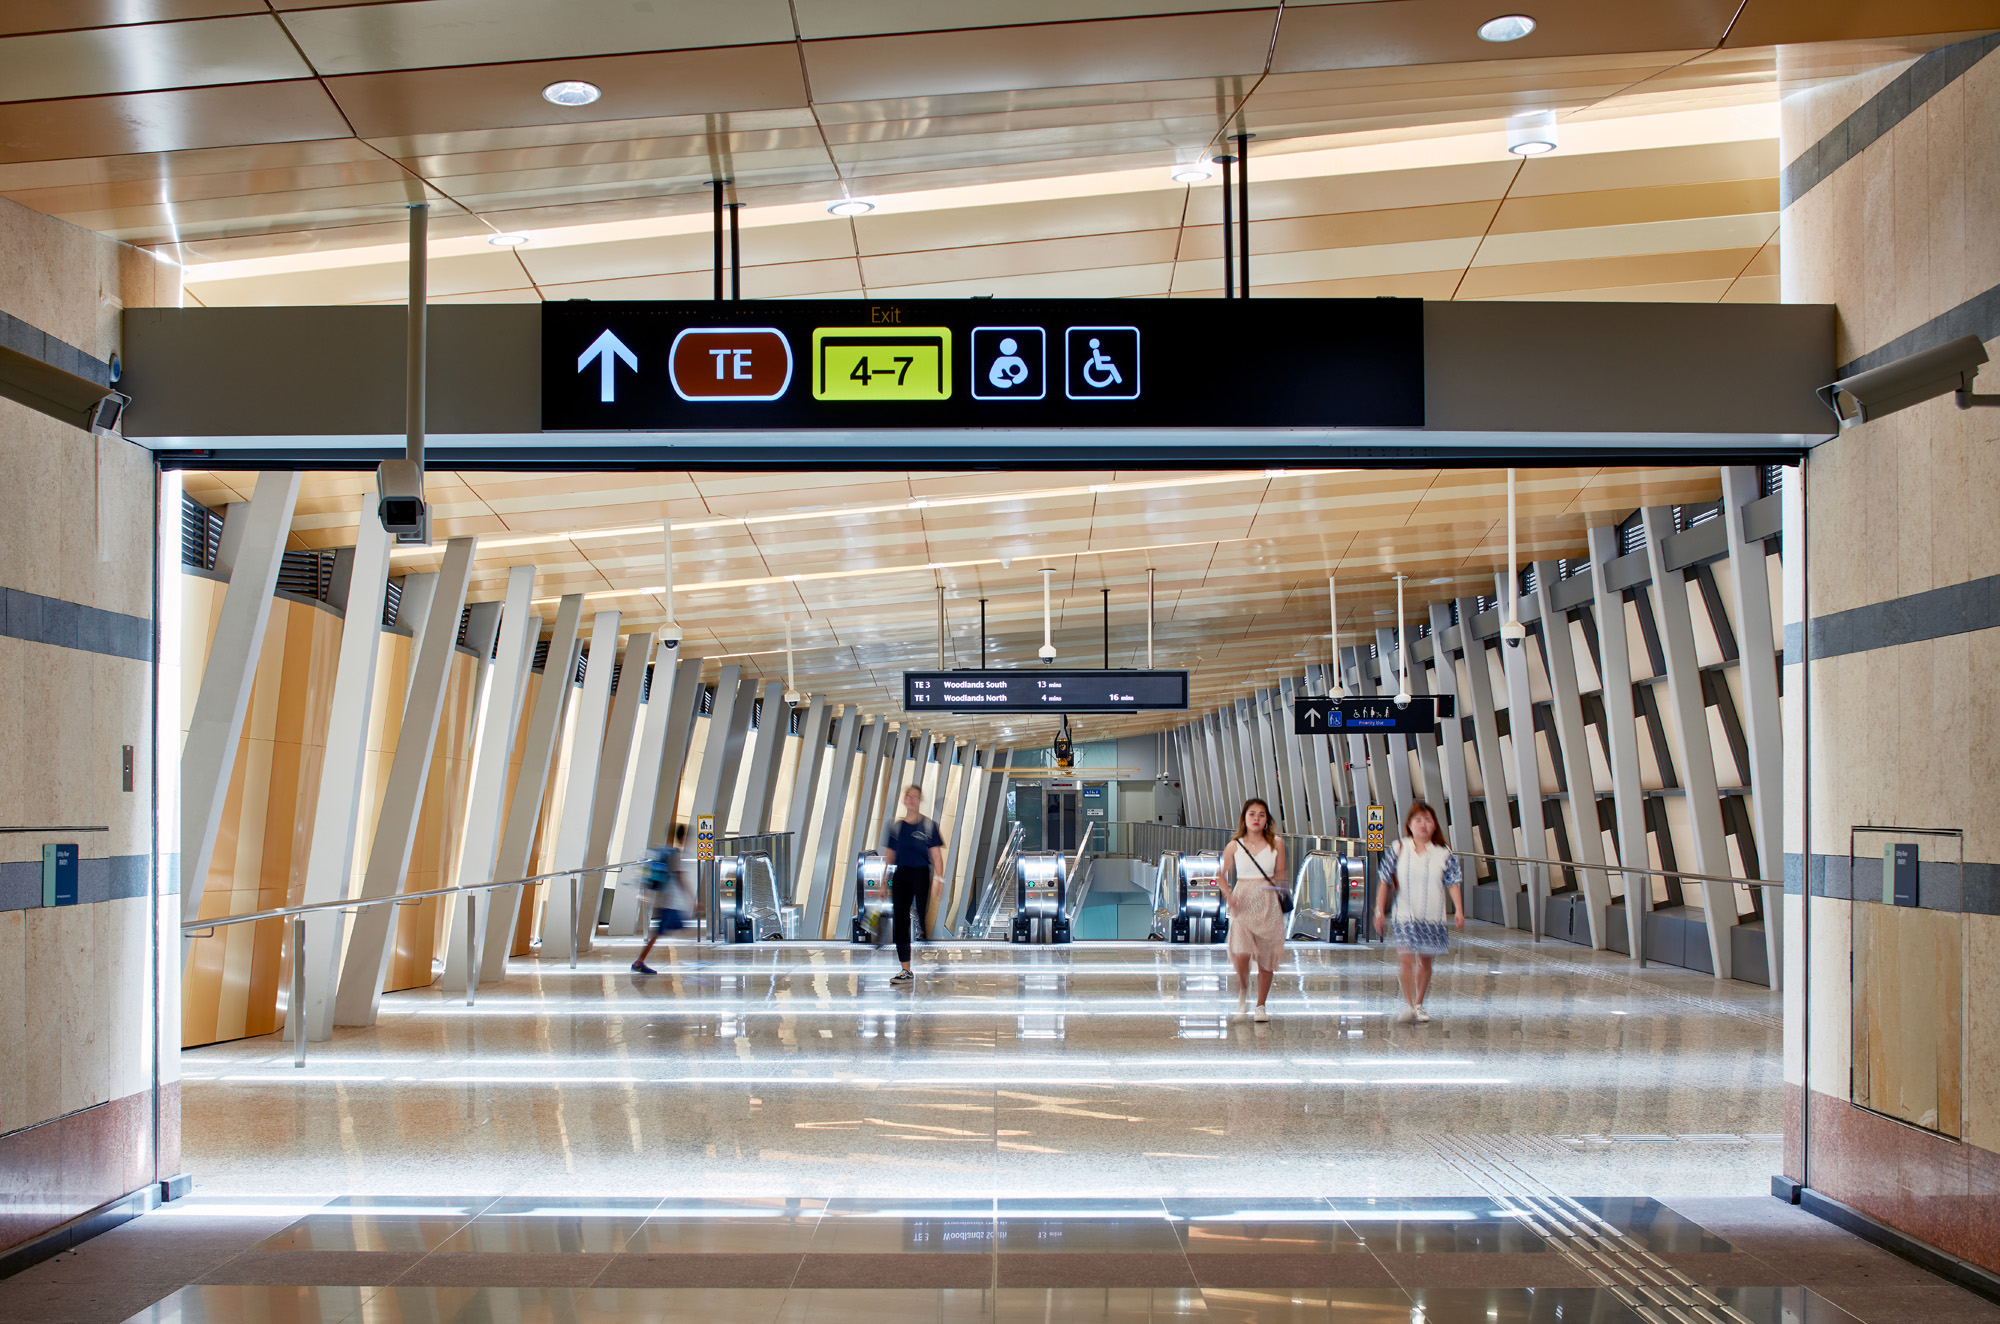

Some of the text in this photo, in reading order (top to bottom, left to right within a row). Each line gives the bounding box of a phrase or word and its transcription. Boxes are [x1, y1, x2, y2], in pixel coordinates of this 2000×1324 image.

[871, 306, 901, 323] Exit
[708, 348, 753, 380] TE
[914, 681, 925, 689] TE
[925, 681, 931, 689] 3
[943, 680, 985, 689] Woodlands
[985, 680, 1008, 689] South
[1037, 680, 1047, 689] 13
[914, 694, 925, 702] TE
[943, 693, 985, 702] Woodlands
[985, 693, 1008, 702] North
[1041, 694, 1047, 702] 4
[1108, 693, 1120, 702] 16
[1120, 694, 1135, 702] mins
